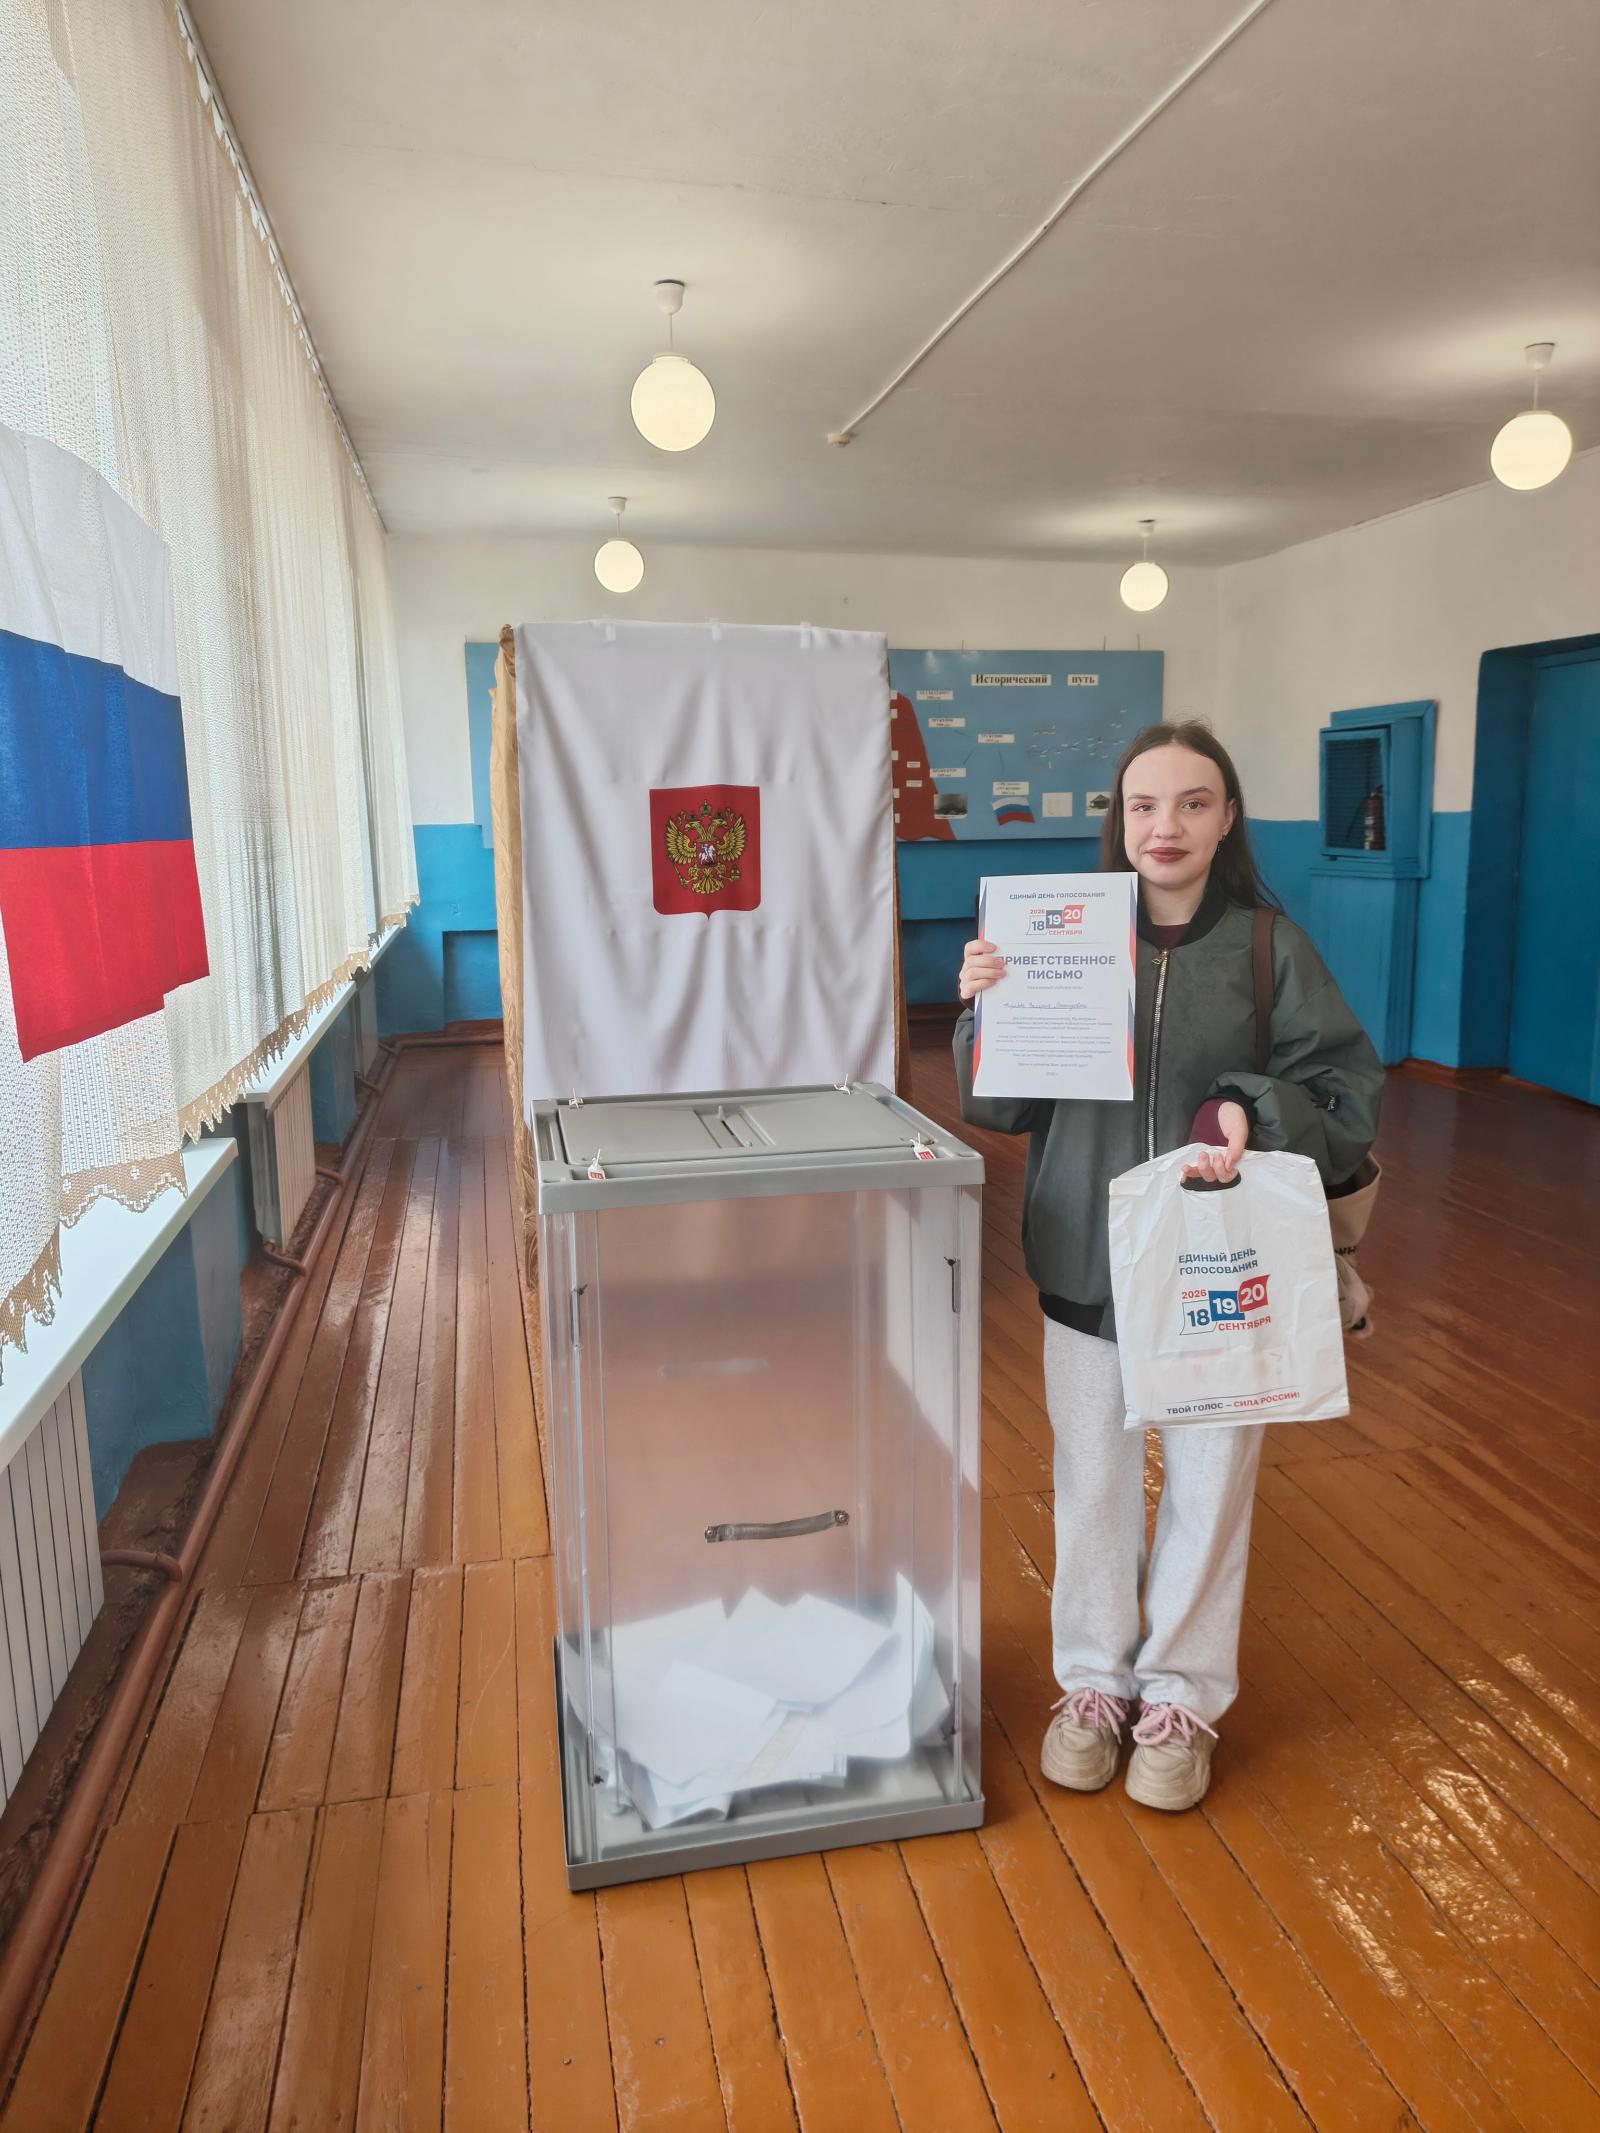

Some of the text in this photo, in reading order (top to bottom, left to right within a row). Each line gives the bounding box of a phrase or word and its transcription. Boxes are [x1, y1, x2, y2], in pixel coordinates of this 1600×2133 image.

[976, 674, 1095, 686] Исторический путь
[1031, 909, 1081, 931] 18 19 20
[1027, 970, 1083, 979] ПИСЬМО
[1179, 1248, 1256, 1263] ЕДИНЫЙ ДЕНЬ
[1180, 1260, 1258, 1275] ГОЛОСОВАНИЯ
[1182, 1290, 1207, 1299] 2026
[1187, 1283, 1265, 1327] 18 19 20
[1218, 1315, 1271, 1331] СЕНТЯБРЯ
[1167, 1406, 1191, 1415] ТВОЙ
[1193, 1402, 1223, 1412] ГОЛОС
[1233, 1399, 1259, 1408] СИЛА
[1261, 1391, 1300, 1404] РОССИИ!
